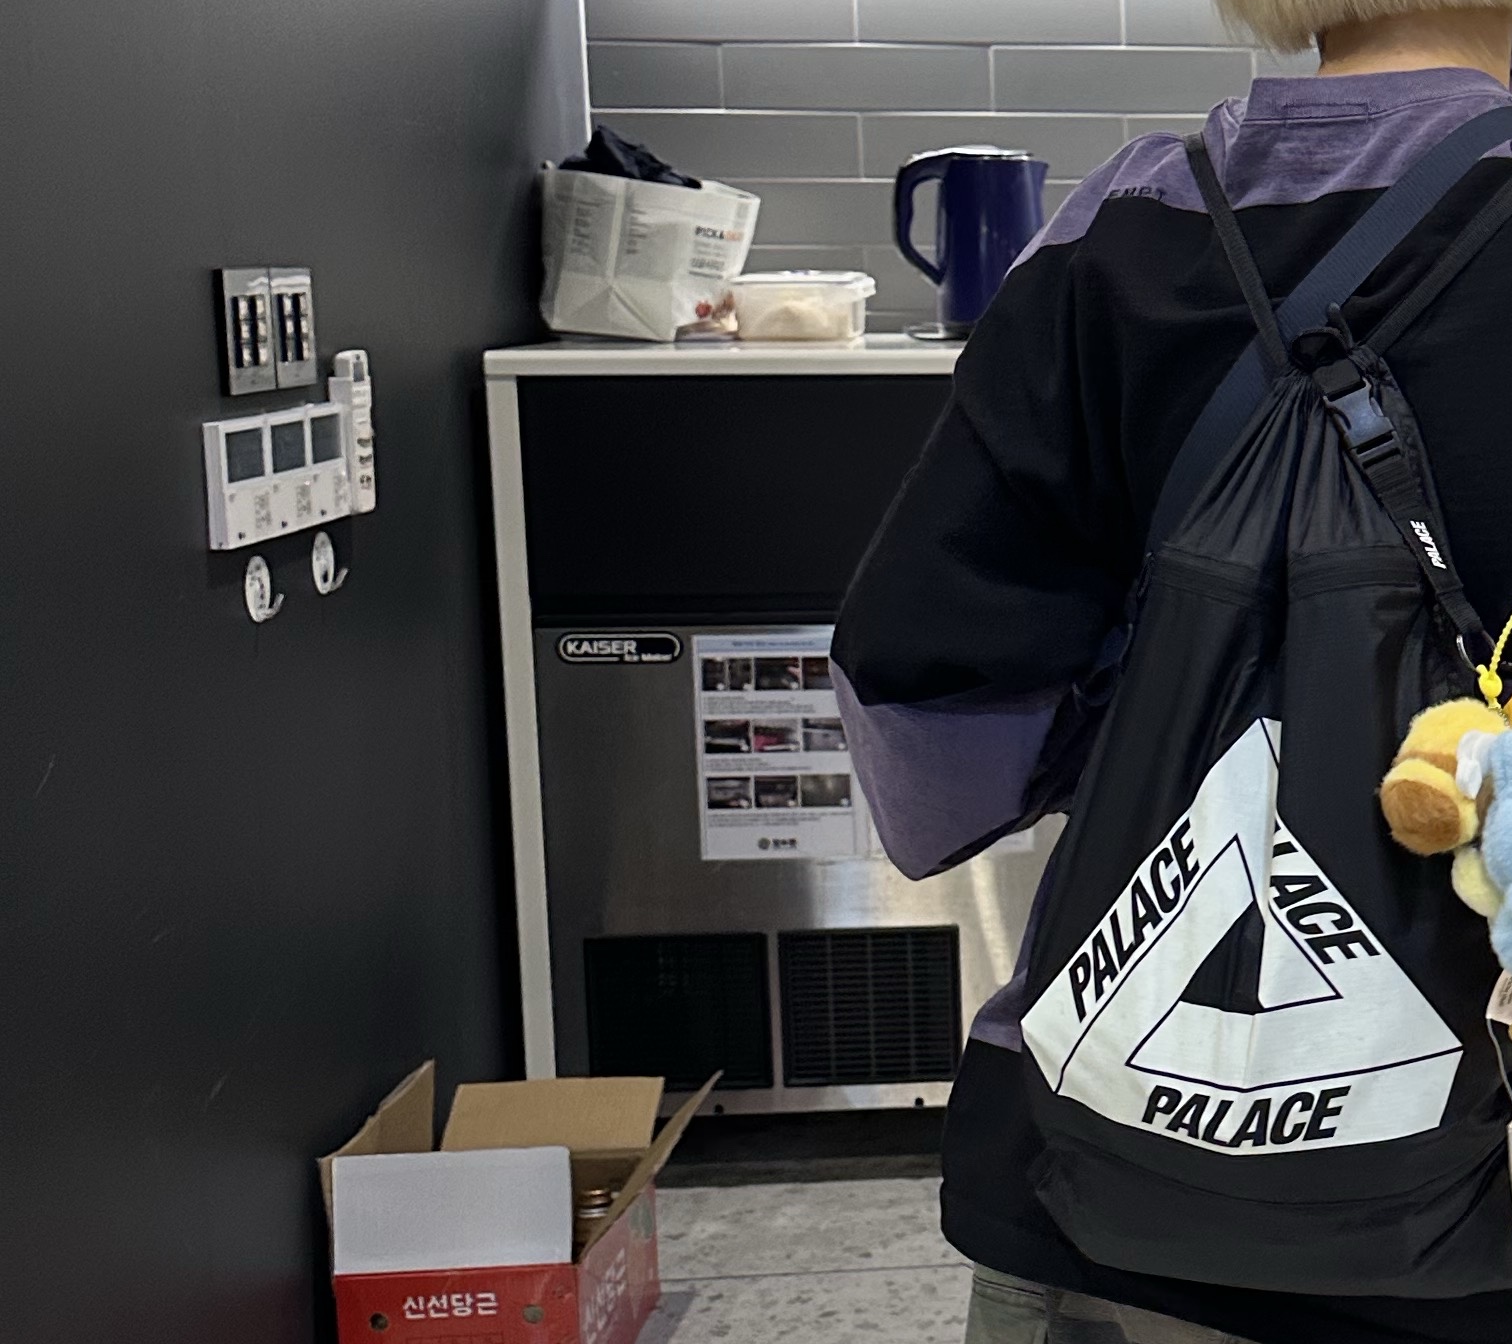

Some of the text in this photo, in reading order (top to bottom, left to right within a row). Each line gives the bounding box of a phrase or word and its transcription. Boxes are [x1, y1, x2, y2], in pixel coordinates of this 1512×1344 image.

[1410, 521, 1447, 569] PALACE
[566, 640, 636, 655] KAISER
[1068, 817, 1200, 1023] PALACE
[1142, 1085, 1351, 1148] PALACE
[402, 1292, 498, 1319] 신선당근
